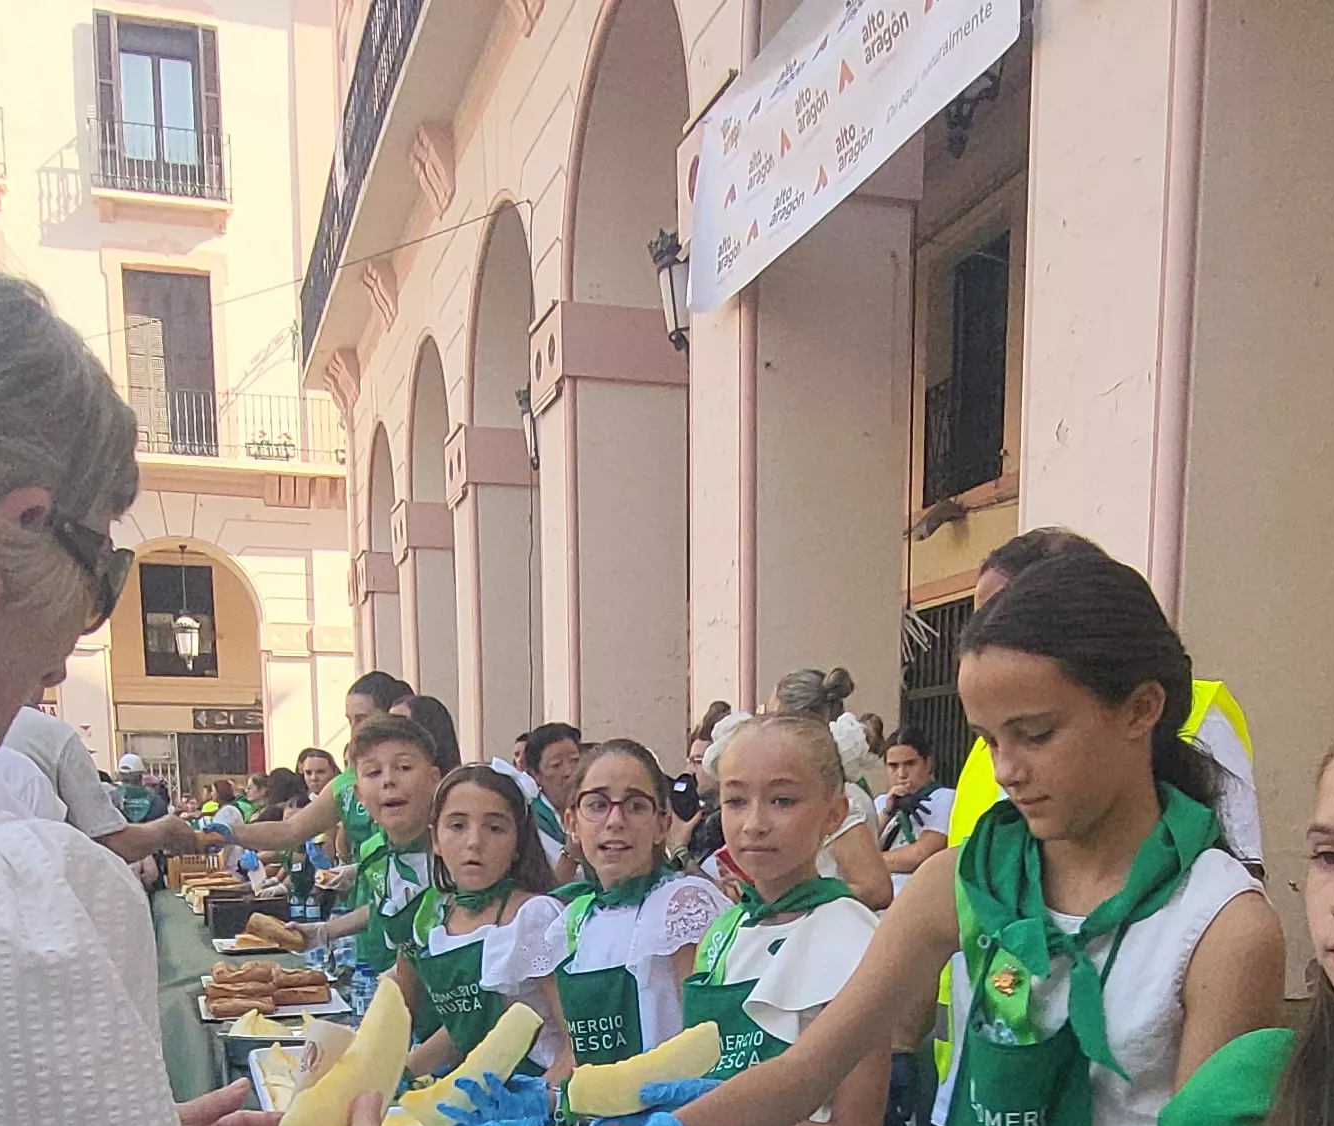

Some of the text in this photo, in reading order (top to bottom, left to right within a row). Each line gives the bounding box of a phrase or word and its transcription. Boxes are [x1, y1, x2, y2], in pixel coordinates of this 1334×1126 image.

[861, 9, 885, 44] alto
[864, 9, 910, 65] aragón
[794, 87, 812, 116] alto
[796, 88, 830, 135] aragón
[835, 123, 857, 153] alto
[837, 126, 875, 173] aragón
[769, 189, 806, 228] aragón
[772, 186, 793, 211] alto
[567, 1014, 624, 1035] MERCIO
